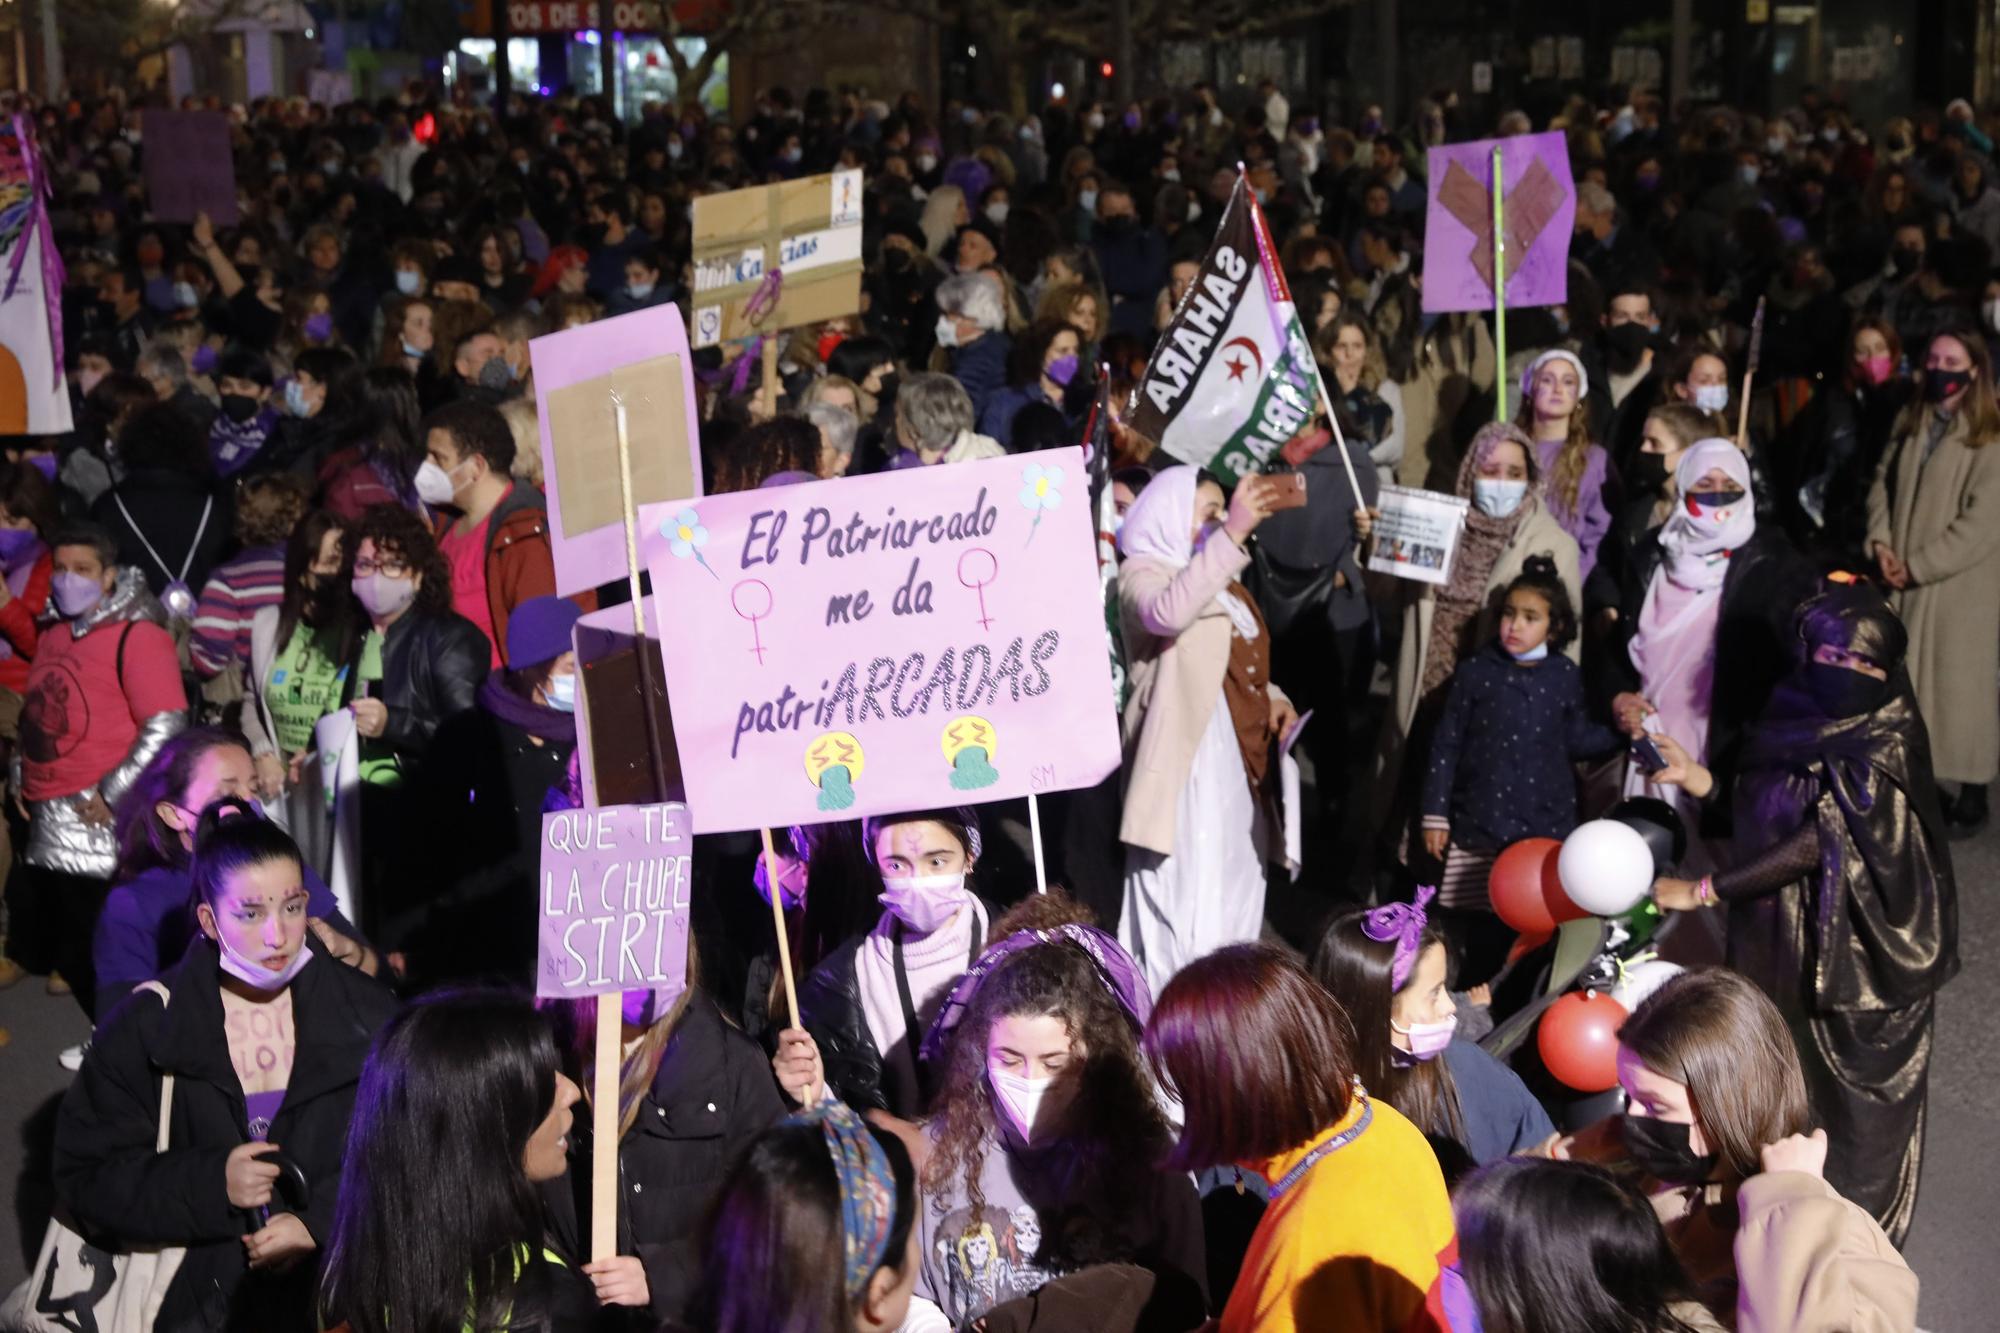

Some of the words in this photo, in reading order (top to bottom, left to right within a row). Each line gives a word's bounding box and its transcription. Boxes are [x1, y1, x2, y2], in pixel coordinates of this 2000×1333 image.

[741, 508, 788, 570] El
[799, 487, 998, 566] Patriarcado
[826, 589, 875, 627] me
[891, 556, 935, 617] da
[730, 629, 1060, 760] patriARCADAS
[548, 810, 618, 855] QUE
[639, 804, 685, 843] TE
[545, 868, 584, 917] LA
[601, 855, 692, 912] CHUPE
[562, 909, 675, 988] SIRI
